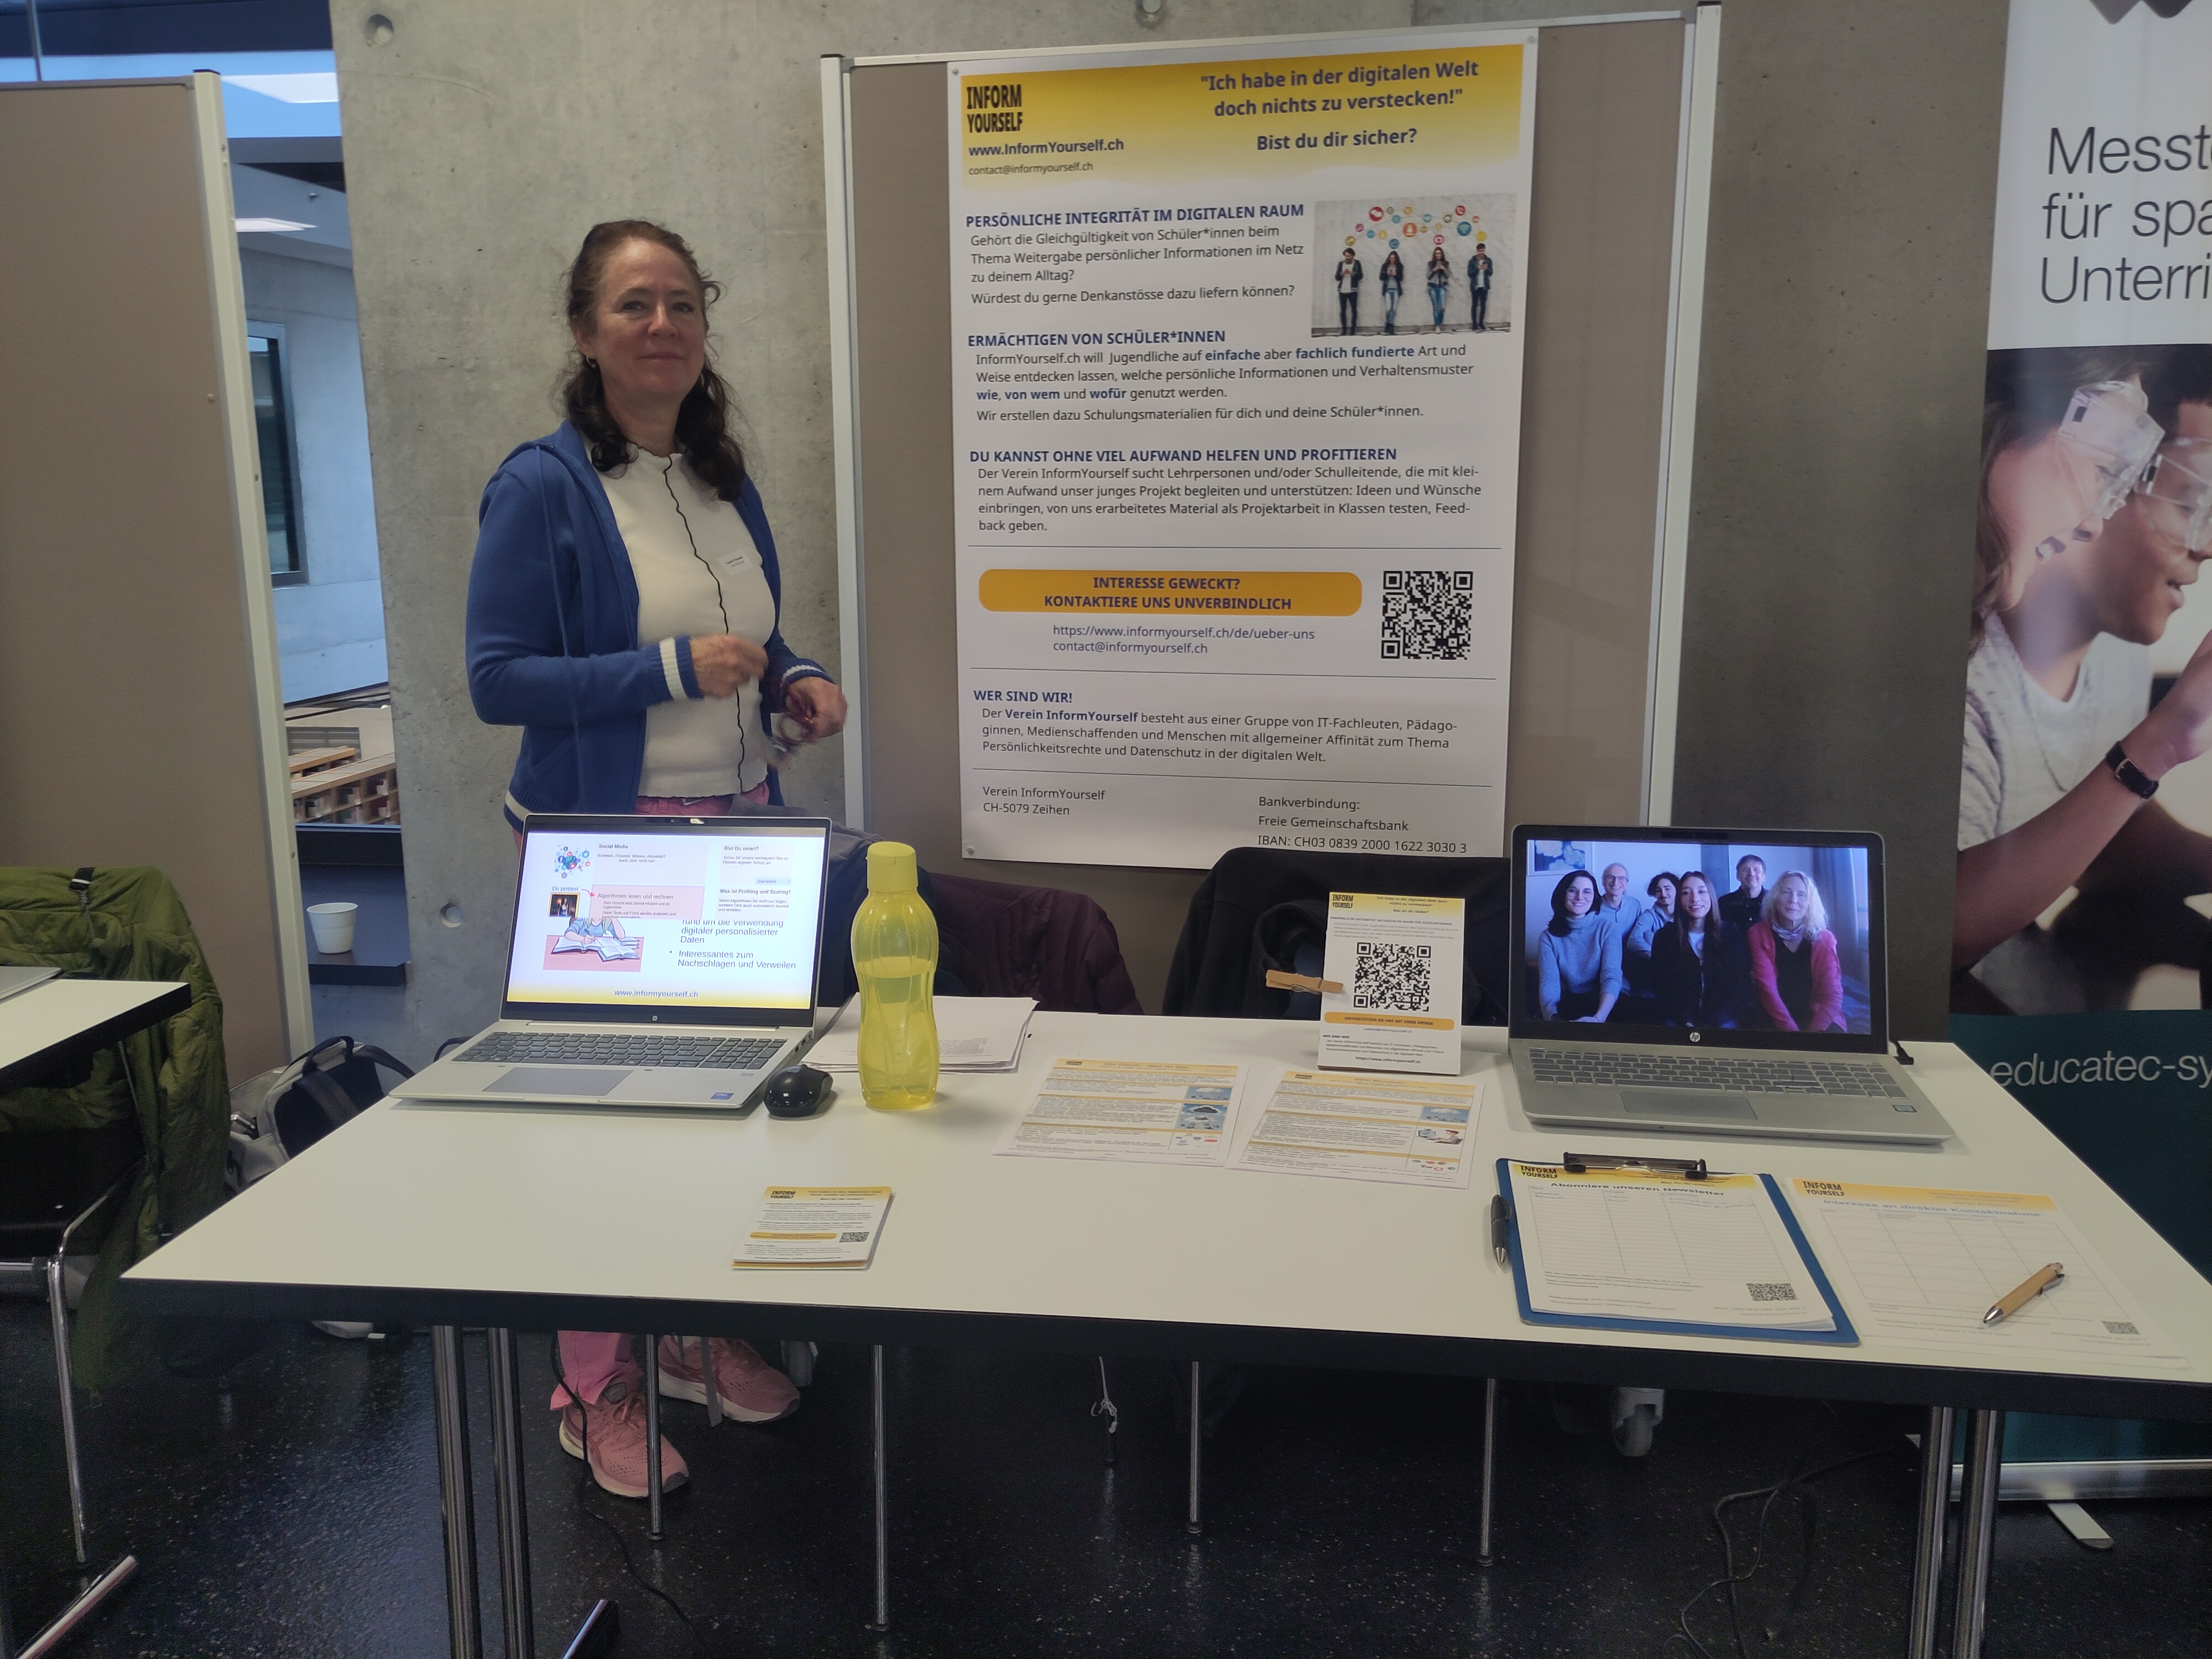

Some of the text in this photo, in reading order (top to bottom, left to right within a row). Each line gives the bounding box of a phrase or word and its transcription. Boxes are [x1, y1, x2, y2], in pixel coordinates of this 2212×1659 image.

[1201, 60, 1479, 91] "Ich habe in der digitalen Welt
[967, 84, 1022, 110] INFORM
[1214, 88, 1463, 116] doch nichts zu verstecken!"
[967, 111, 1023, 133] YOURSELF
[1257, 128, 1417, 150] Bist du dir sicher?
[968, 138, 1124, 156] www.InformYourself.ch
[2048, 125, 2212, 175] Messt
[968, 161, 1093, 175] contact@informyourself.ch
[966, 204, 1303, 227] PERSÖNLICHE INTEGRITÄT IM DIGITALEN RAUM
[2042, 192, 2112, 240] für
[971, 234, 1012, 246] Gehört
[1015, 233, 1032, 244] die
[1036, 231, 1129, 246] Gleichgültigkeit
[1131, 232, 1154, 241] von
[1248, 226, 1279, 237] beim
[988, 271, 1031, 282] deinem
[1035, 269, 1074, 283] Alltag?
[971, 285, 1295, 305] Würdest du gerne Denkanstösse dazu liefern können?
[968, 332, 1067, 347] ERMÄCHTIGEN
[1071, 333, 1102, 345] VON
[976, 410, 997, 421] Wir
[1000, 410, 1050, 421] erstellen
[1053, 409, 1080, 420] dazu
[1083, 408, 1212, 422] Schulungsmaterialien
[1215, 408, 1234, 419] für
[1236, 407, 1261, 419] dich
[1265, 406, 1288, 418] und
[1292, 406, 1327, 418] deine
[970, 448, 1396, 462] DU KANNST OHNE VIEL AUFWAND HELFEN UND PROFITIEREN
[979, 520, 1047, 533] back geben.
[1093, 577, 1240, 589] INTERESSE GEWECKT?
[1045, 596, 1291, 609] KONTAKTIERE UNS UNVERBINDLICH
[1053, 625, 1314, 640] https://www.informyourself.ch/de/ueber-uns
[1053, 641, 1207, 655] contact@informyourself.ch
[973, 690, 1072, 703] WER SIND WIR!
[982, 786, 1105, 800] Verein InformYourself
[983, 802, 1069, 815] CH-5079 Zeihen
[1259, 796, 1360, 812] Bankverbindung:
[1259, 816, 1408, 831] Freie Gemeinschaftsbank
[1258, 835, 1466, 853] IBAN: CH03 0839 2000 1622 3030 3
[681, 927, 779, 937] digitaler personalisierter
[680, 936, 705, 944] Daten
[679, 950, 734, 959] Interessantes
[678, 959, 735, 969] Nachschlagen
[614, 989, 698, 999] www.informyourself.ch
[1691, 1032, 1699, 1042] hp
[1521, 1165, 1557, 1174] INFORM
[1663, 1187, 1725, 1196] Newsletter
[1802, 1181, 1843, 1191] INFORM
[1823, 1199, 1879, 1208] Interesse
[1900, 1203, 1947, 1212] direkter
[1950, 1208, 2041, 1218] Kontaktnahme
